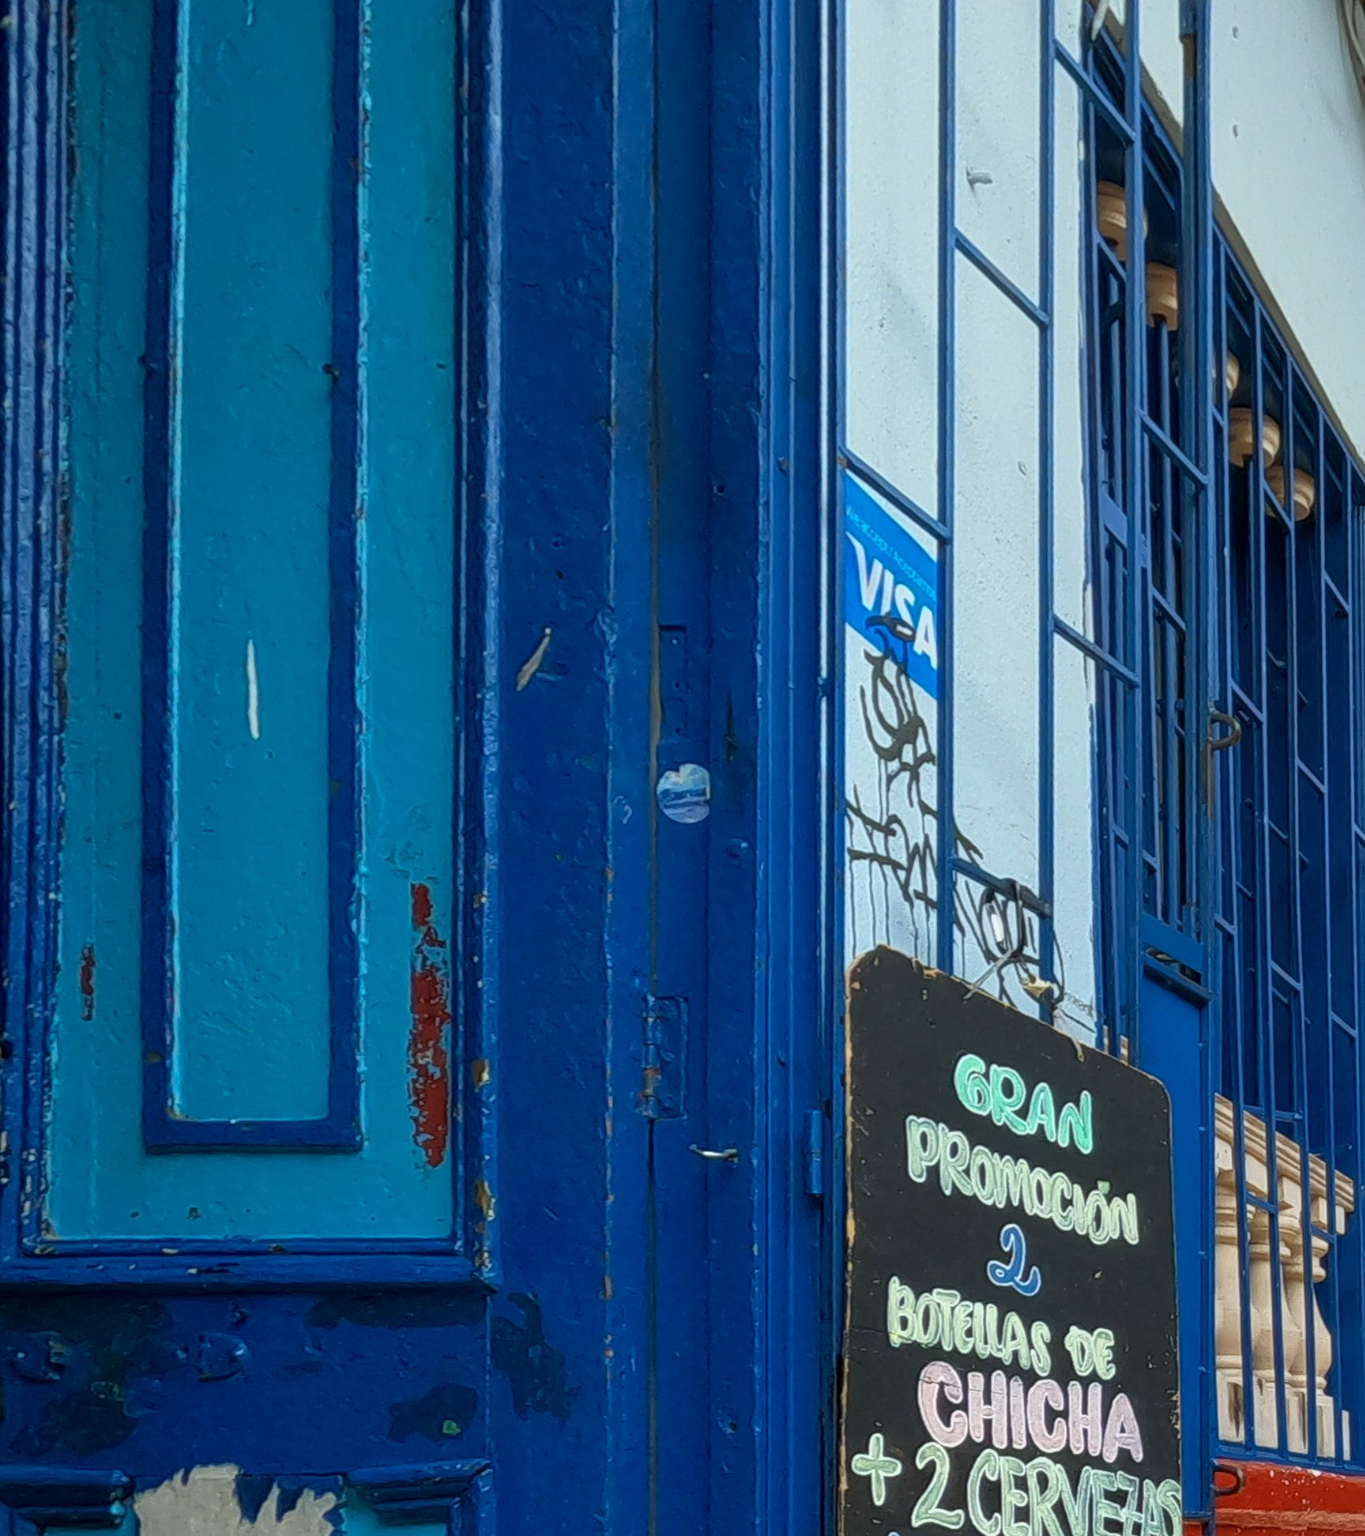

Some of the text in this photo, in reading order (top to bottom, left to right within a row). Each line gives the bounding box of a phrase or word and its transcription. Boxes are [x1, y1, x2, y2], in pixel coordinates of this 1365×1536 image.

[845, 530, 938, 671] VISA
[954, 1052, 1093, 1155] GRAN
[906, 1114, 1139, 1246] PROMOCIÓN
[986, 1223, 1041, 1298] 2
[887, 1276, 1117, 1381] BOTELLAS DE
[918, 1360, 1145, 1463] CHICHA
[910, 1441, 967, 1530] 2
